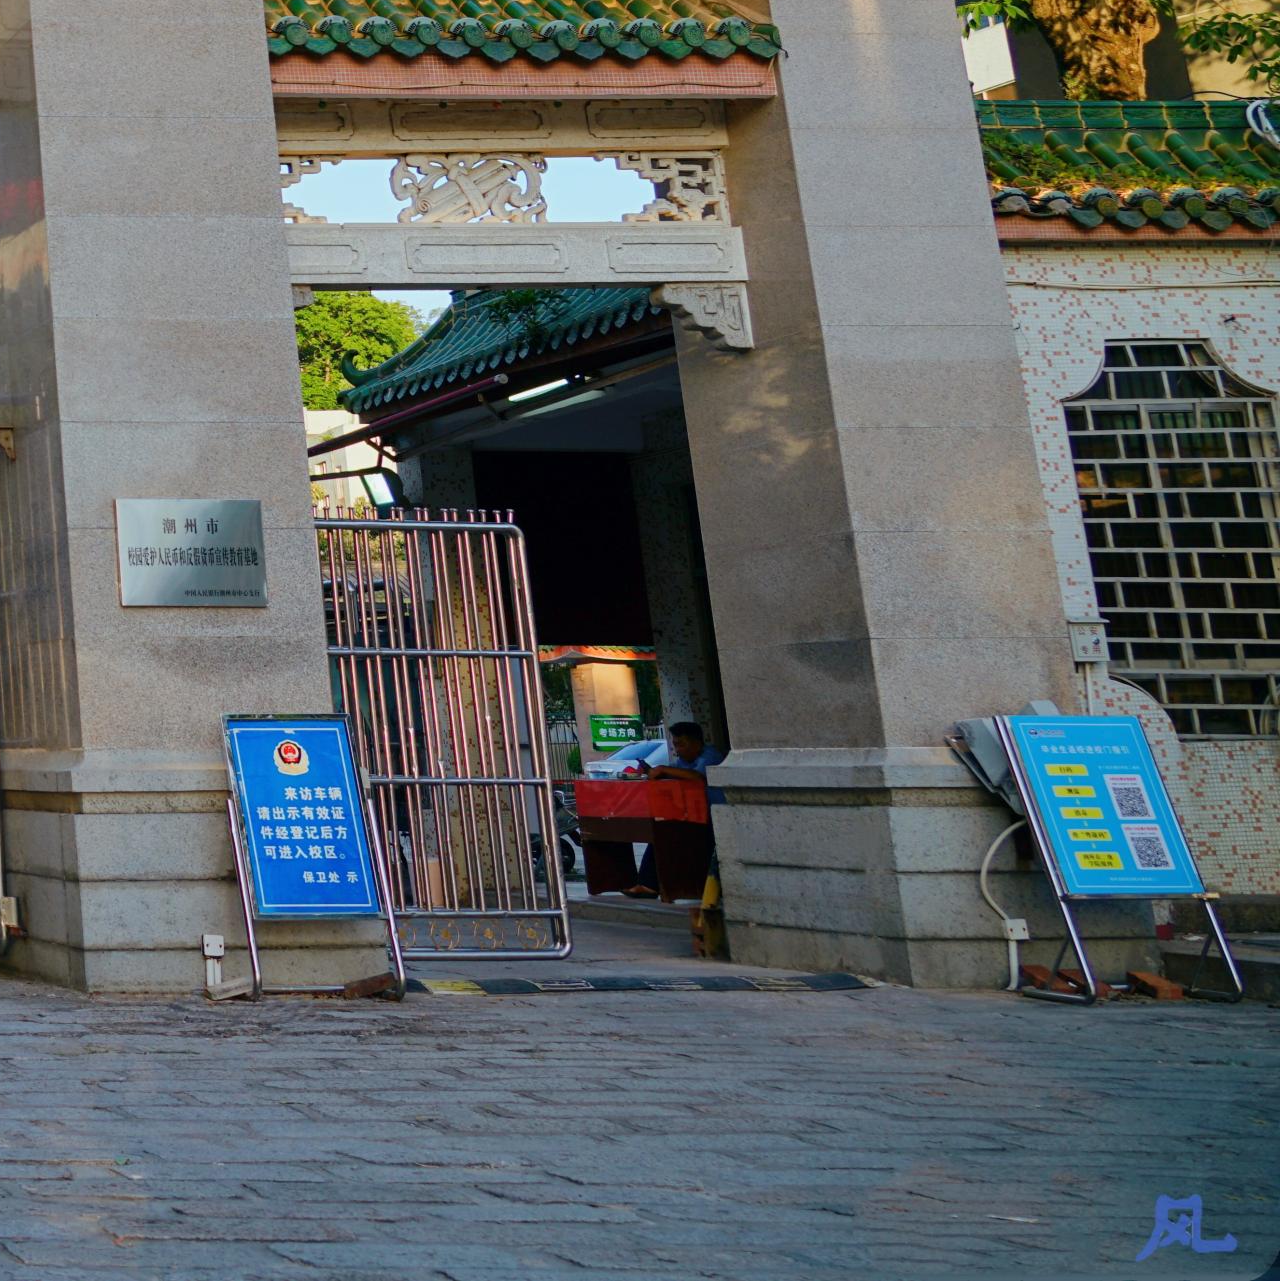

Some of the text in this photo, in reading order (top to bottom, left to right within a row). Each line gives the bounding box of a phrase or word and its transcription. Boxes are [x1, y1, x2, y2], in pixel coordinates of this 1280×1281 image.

[162, 517, 219, 535] 潮州市
[598, 727, 636, 738] 考场方向
[284, 786, 343, 801] 来访车辆
[256, 806, 346, 821] 请出示有效证
[260, 825, 348, 840] 件经登记后方
[263, 845, 346, 861] 可进入校区。
[302, 870, 359, 884] 保卫处 示
